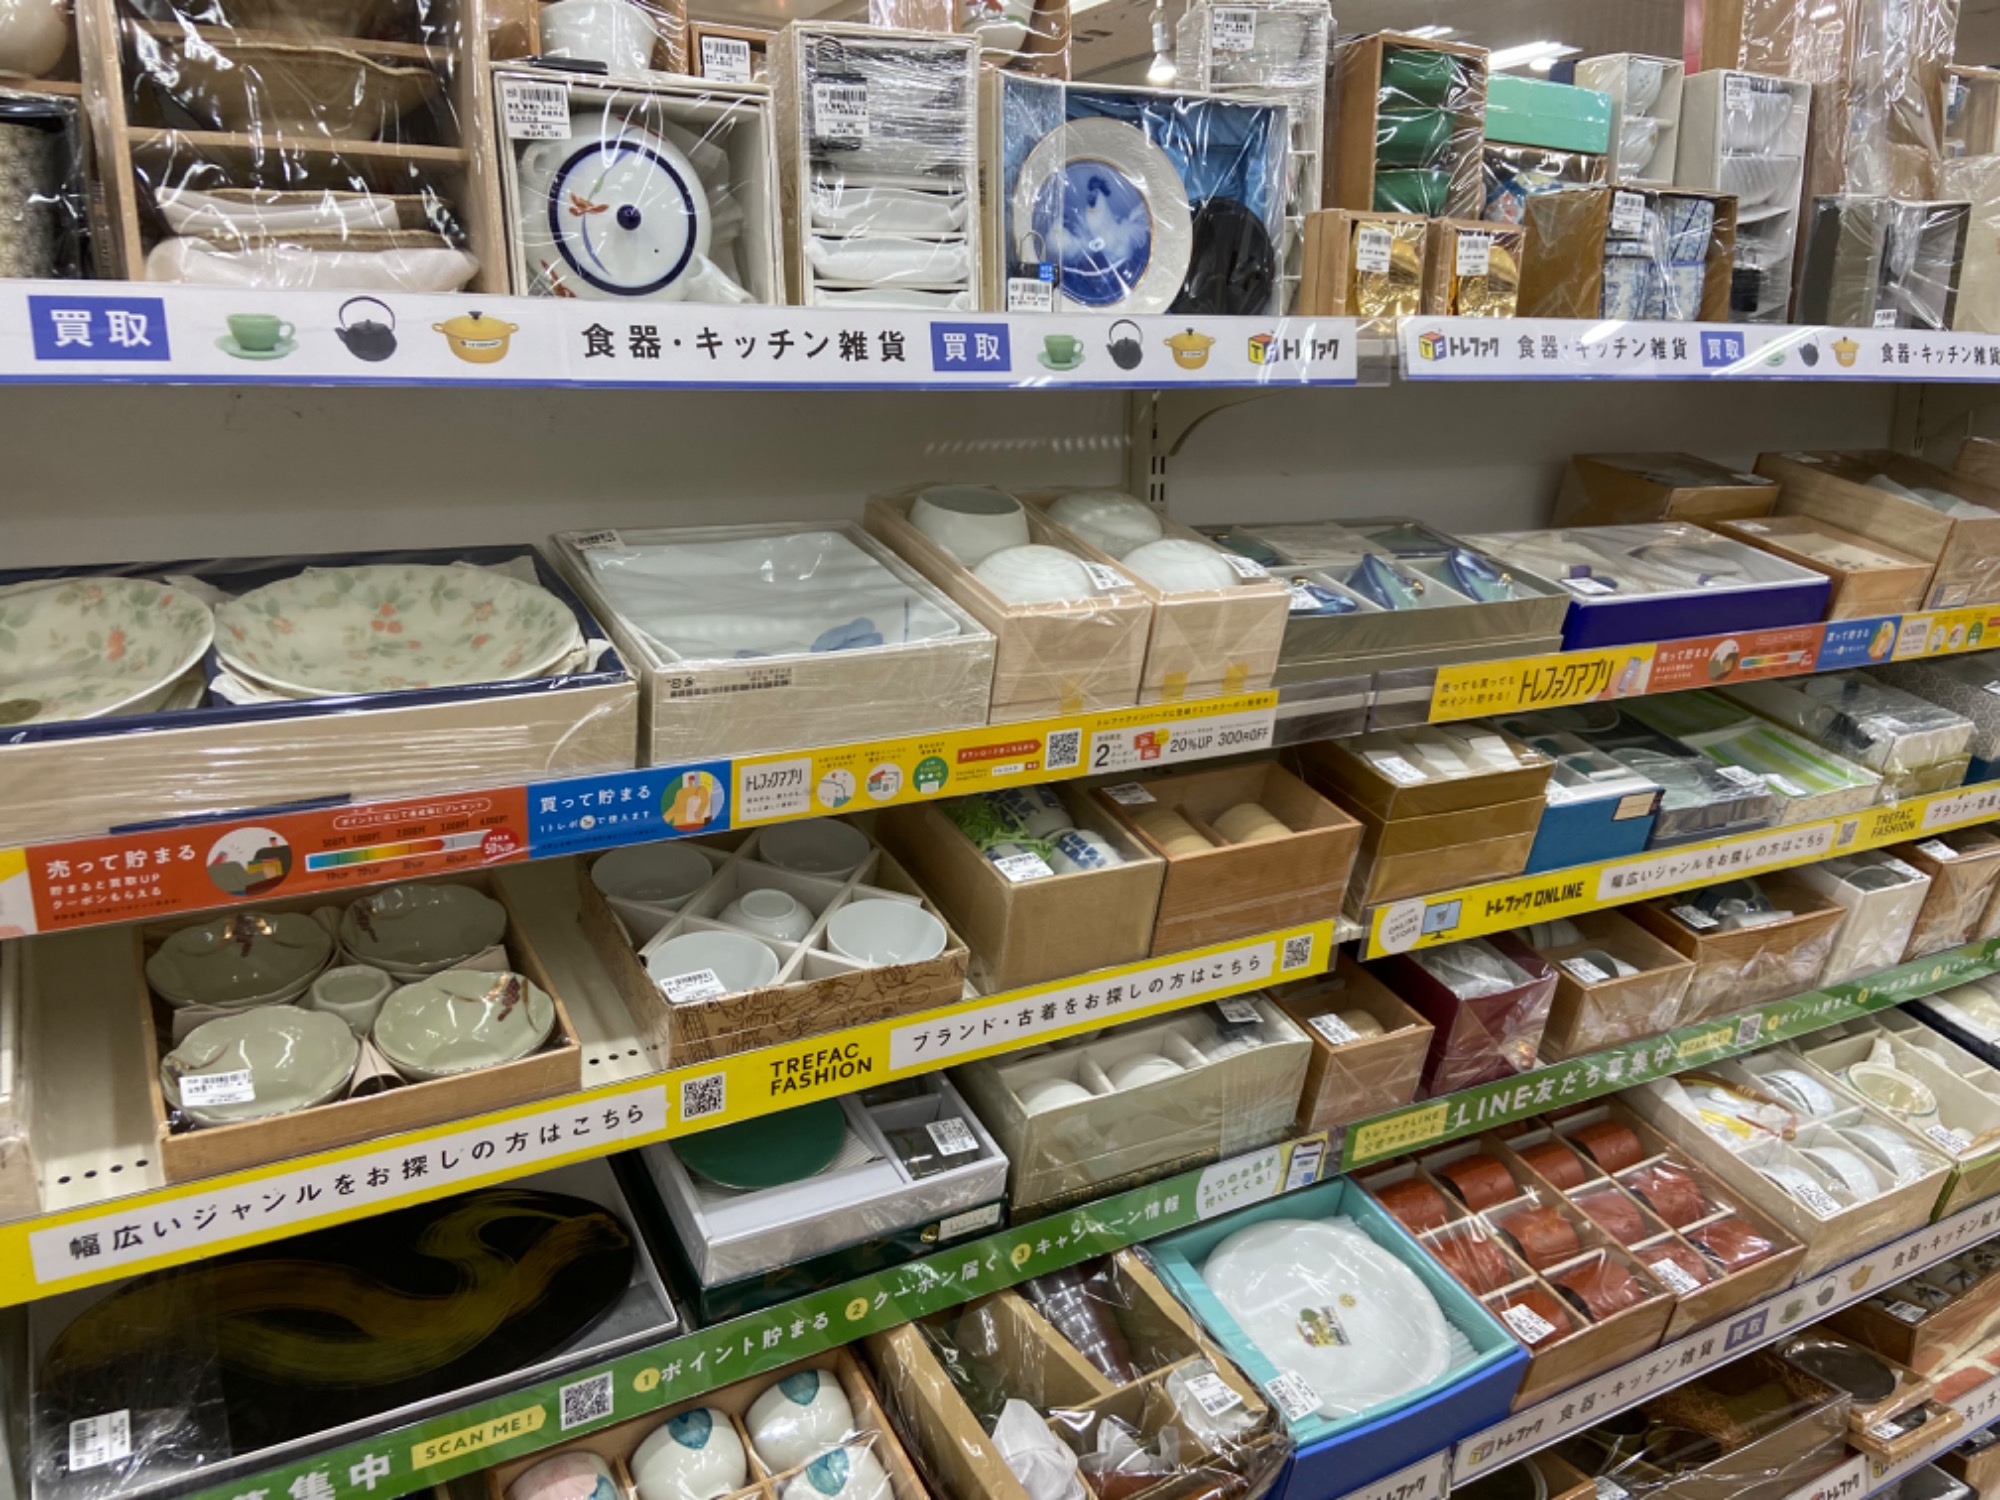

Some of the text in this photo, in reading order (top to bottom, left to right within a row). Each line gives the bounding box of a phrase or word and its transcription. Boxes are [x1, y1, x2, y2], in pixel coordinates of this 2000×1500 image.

[50, 308, 152, 348] 買取
[581, 322, 906, 362] 食器・キッチン雑貨
[942, 332, 1001, 361] 買取
[1450, 337, 1499, 357] トレファク
[1517, 334, 1688, 362] 食器・キッチン雑貨
[1706, 337, 1740, 361] 買取
[1517, 659, 1615, 704] トレファクアプリ
[1094, 744, 1111, 768] 2
[1170, 736, 1214, 753] 20%UP
[745, 767, 803, 792] トレファクアプリ
[539, 785, 652, 814] 買って貯まる
[1870, 820, 1916, 838] FASHION
[1876, 807, 1914, 826] TREFAC
[45, 844, 197, 880] 売って貯まる
[1609, 831, 1826, 890] 幅広いジャンルをお探しの方はこちら
[49, 873, 162, 896] 貯まると買取UP
[51, 886, 162, 910] クーポンもらえる
[1533, 880, 1586, 909] ONLINE
[912, 953, 1264, 1053] ブランド・古着をお探しの方はこちら
[770, 1043, 859, 1078] TREFAC
[771, 1057, 872, 1096] FASHION
[1456, 1043, 1673, 1128] LINE友だち募集中
[68, 1103, 646, 1260] 幅広いジャンルをお探しの方はこちら
[1732, 1317, 1764, 1343] 買取
[660, 1310, 829, 1383] ポイント貯まる
[1556, 1338, 1716, 1425] 食器・キッチン雑貨
[425, 1430, 484, 1460] SCAN
[1496, 1418, 1544, 1451] トレファク
